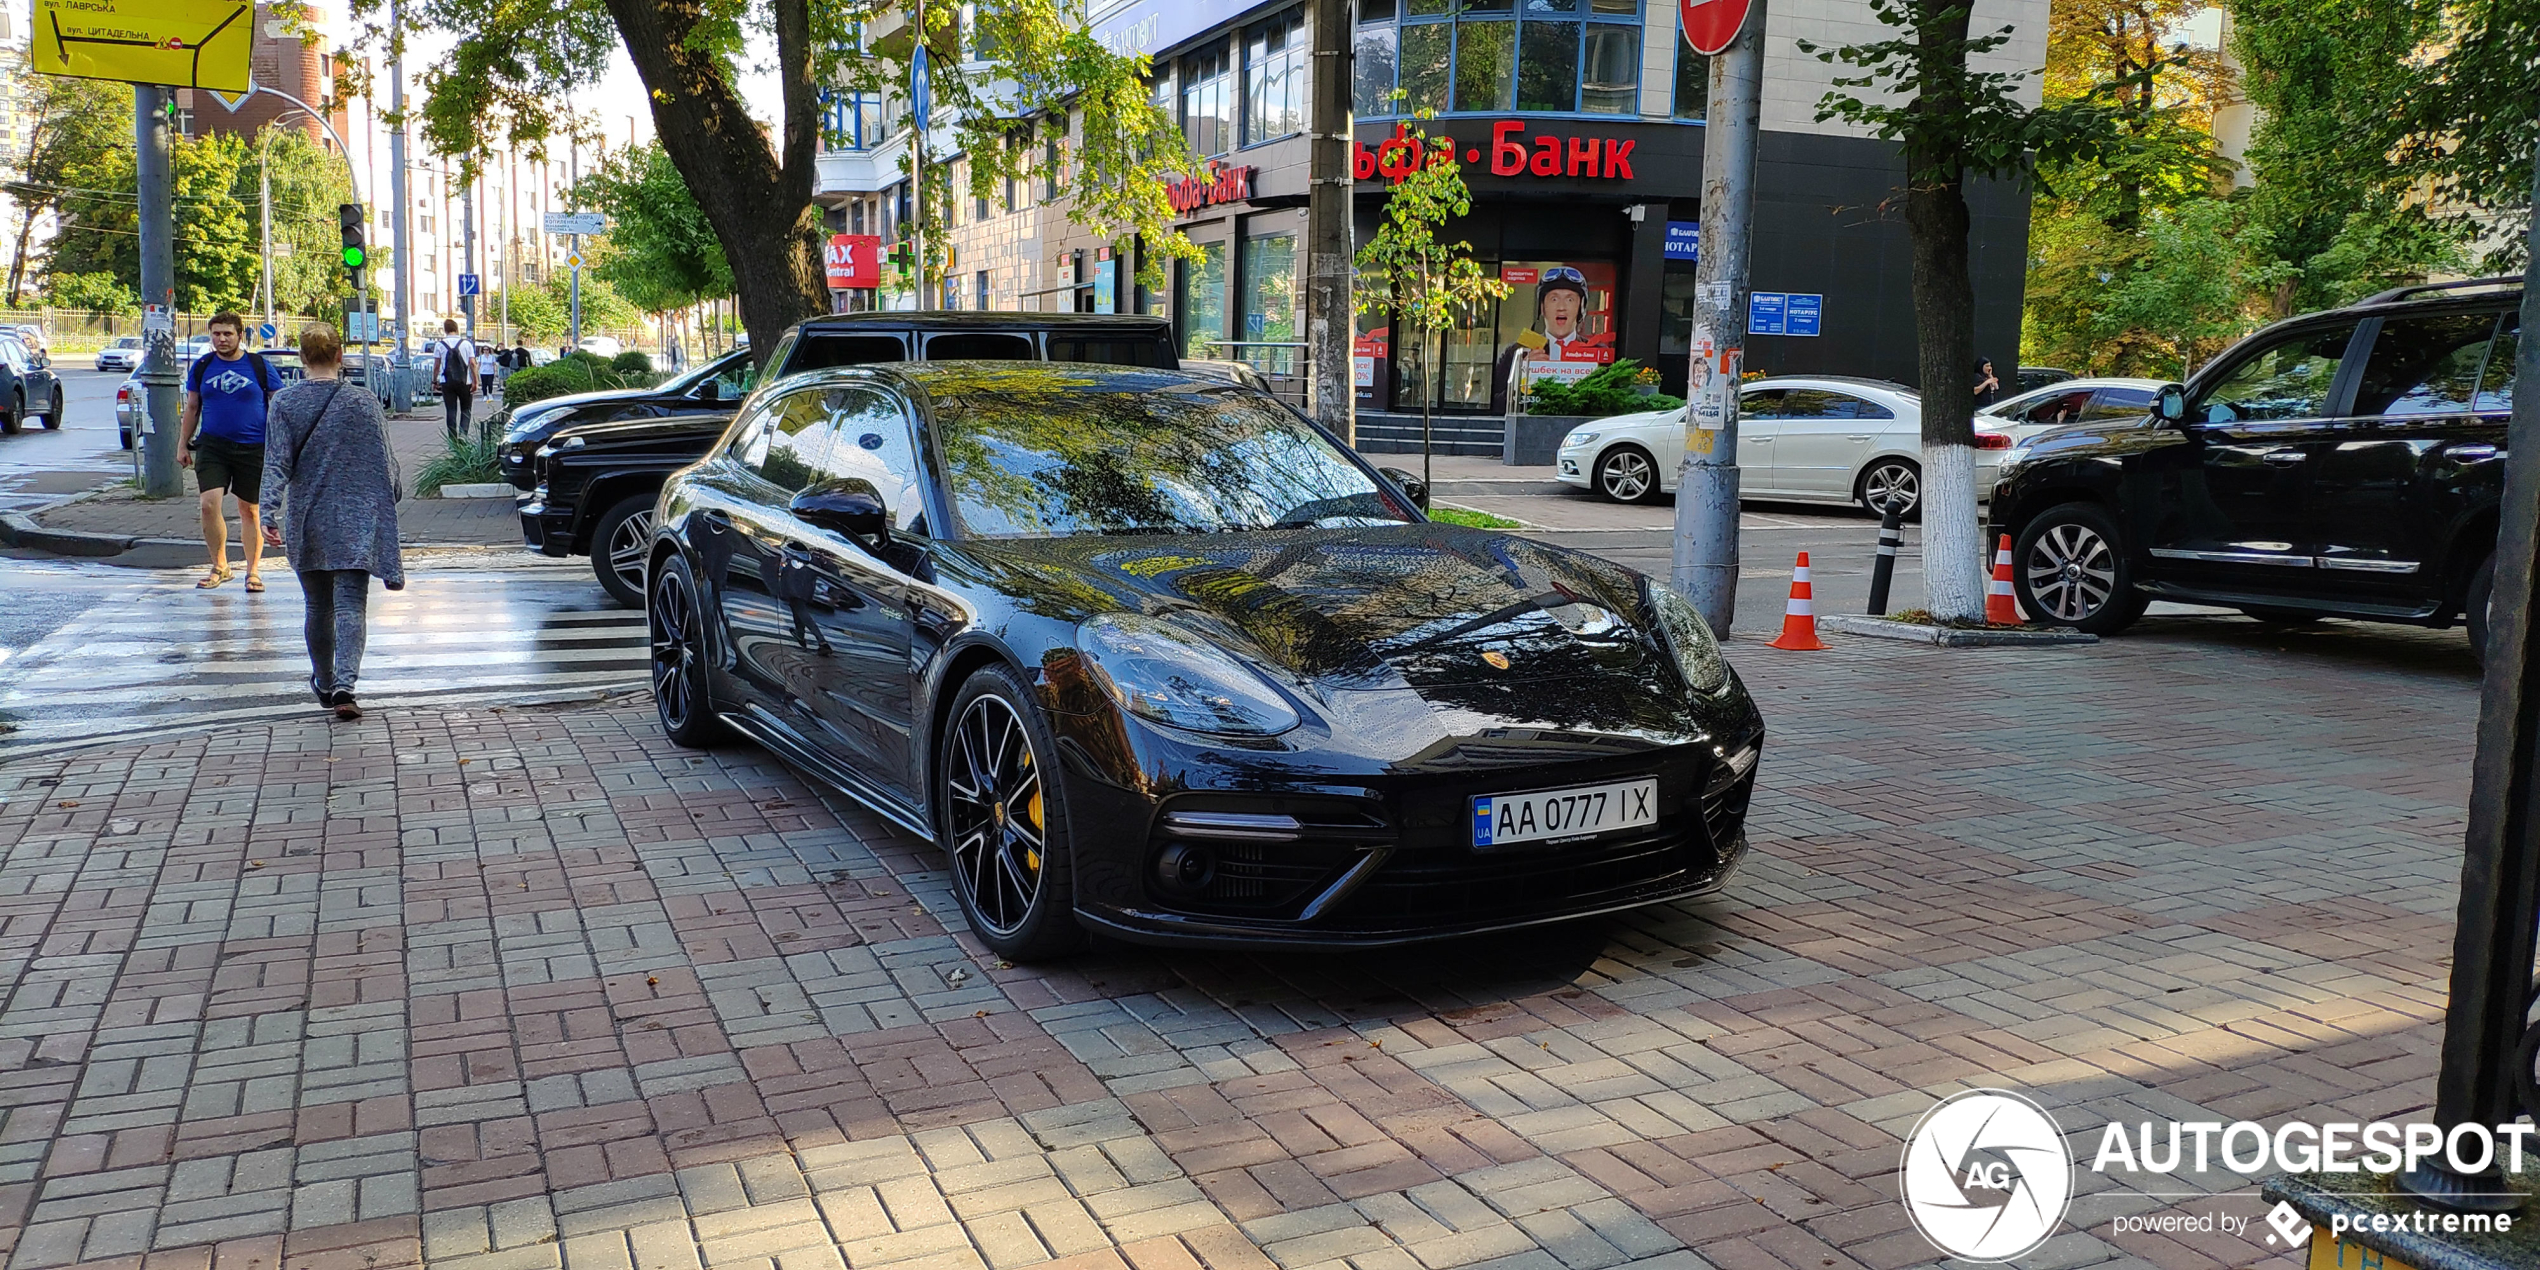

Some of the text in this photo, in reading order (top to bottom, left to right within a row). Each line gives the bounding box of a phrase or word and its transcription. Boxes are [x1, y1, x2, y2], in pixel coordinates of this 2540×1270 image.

[65, 1, 116, 14] ЛАВРСЬКА
[66, 26, 150, 40] вул. ЦИТАДЕЛЬНА
[1491, 121, 1636, 180] Банк
[1497, 801, 1537, 837] AA
[1546, 792, 1607, 831] 0777
[1477, 828, 1491, 839] UA
